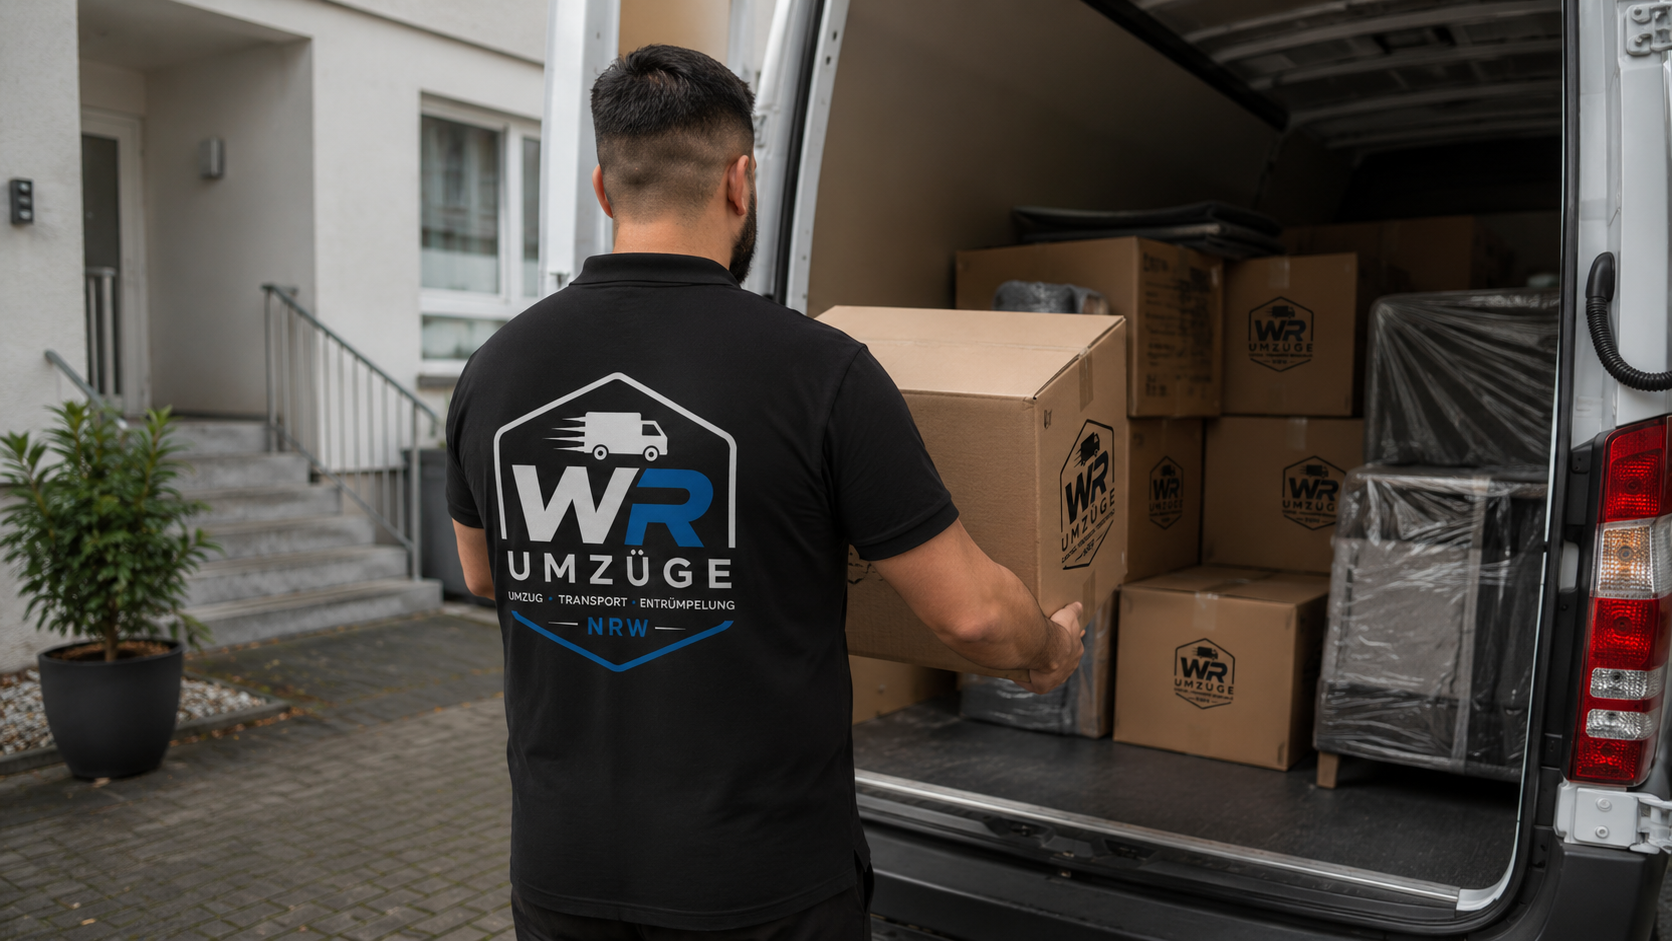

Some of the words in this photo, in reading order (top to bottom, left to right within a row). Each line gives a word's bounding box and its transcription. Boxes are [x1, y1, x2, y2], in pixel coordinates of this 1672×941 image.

[1254, 320, 1307, 342] WR
[1065, 450, 1109, 525] WR
[1153, 477, 1180, 501] WR
[1288, 477, 1339, 502] WR
[511, 464, 714, 548] WR
[1061, 487, 1115, 552] UMZÜGE
[507, 549, 732, 589] UMZÜGE
[508, 591, 543, 603] UMZUG
[558, 594, 627, 607] TRANSPORT
[640, 597, 735, 611] ENTRÜMPELUNG
[587, 616, 648, 638] NRW
[1180, 657, 1228, 684] WR
